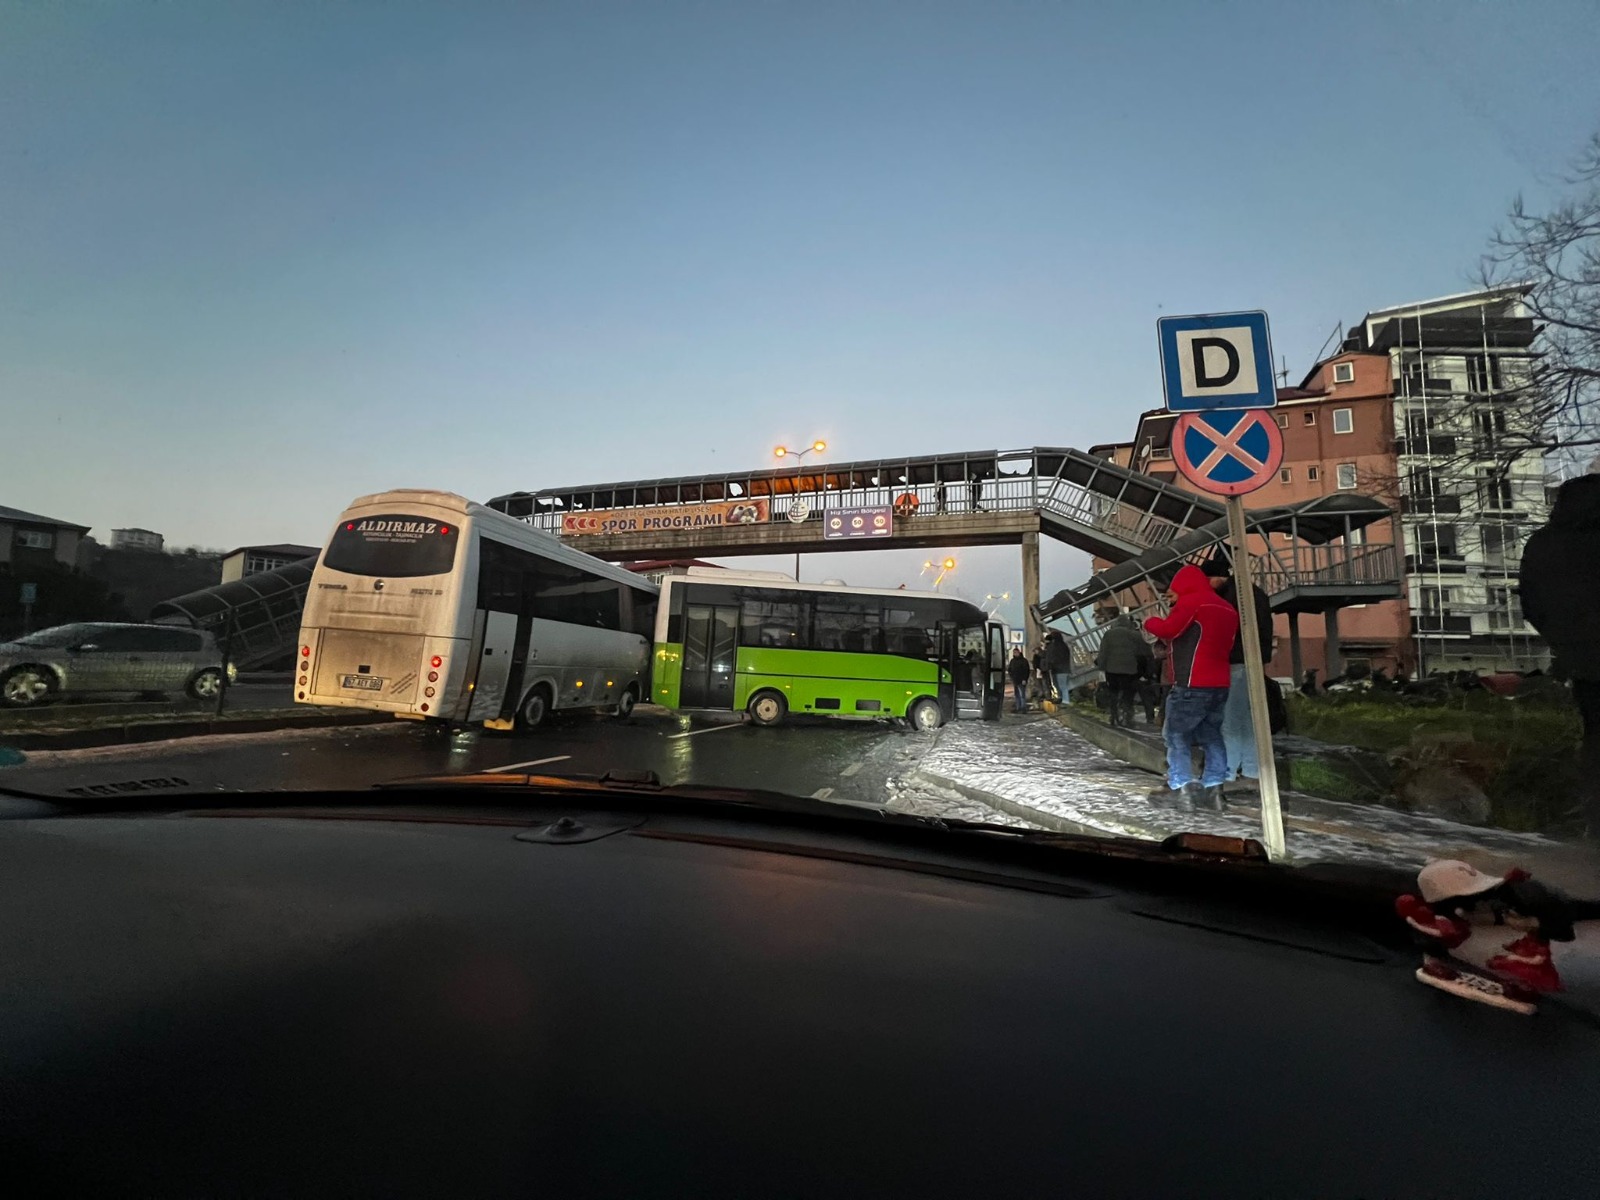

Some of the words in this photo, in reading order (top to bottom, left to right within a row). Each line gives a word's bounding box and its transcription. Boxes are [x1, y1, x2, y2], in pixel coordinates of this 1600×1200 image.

[1191, 337, 1240, 388] D
[357, 520, 437, 534] ALDIRMAZ
[601, 519, 637, 531] SPOR
[643, 513, 722, 529] PROGRAMI
